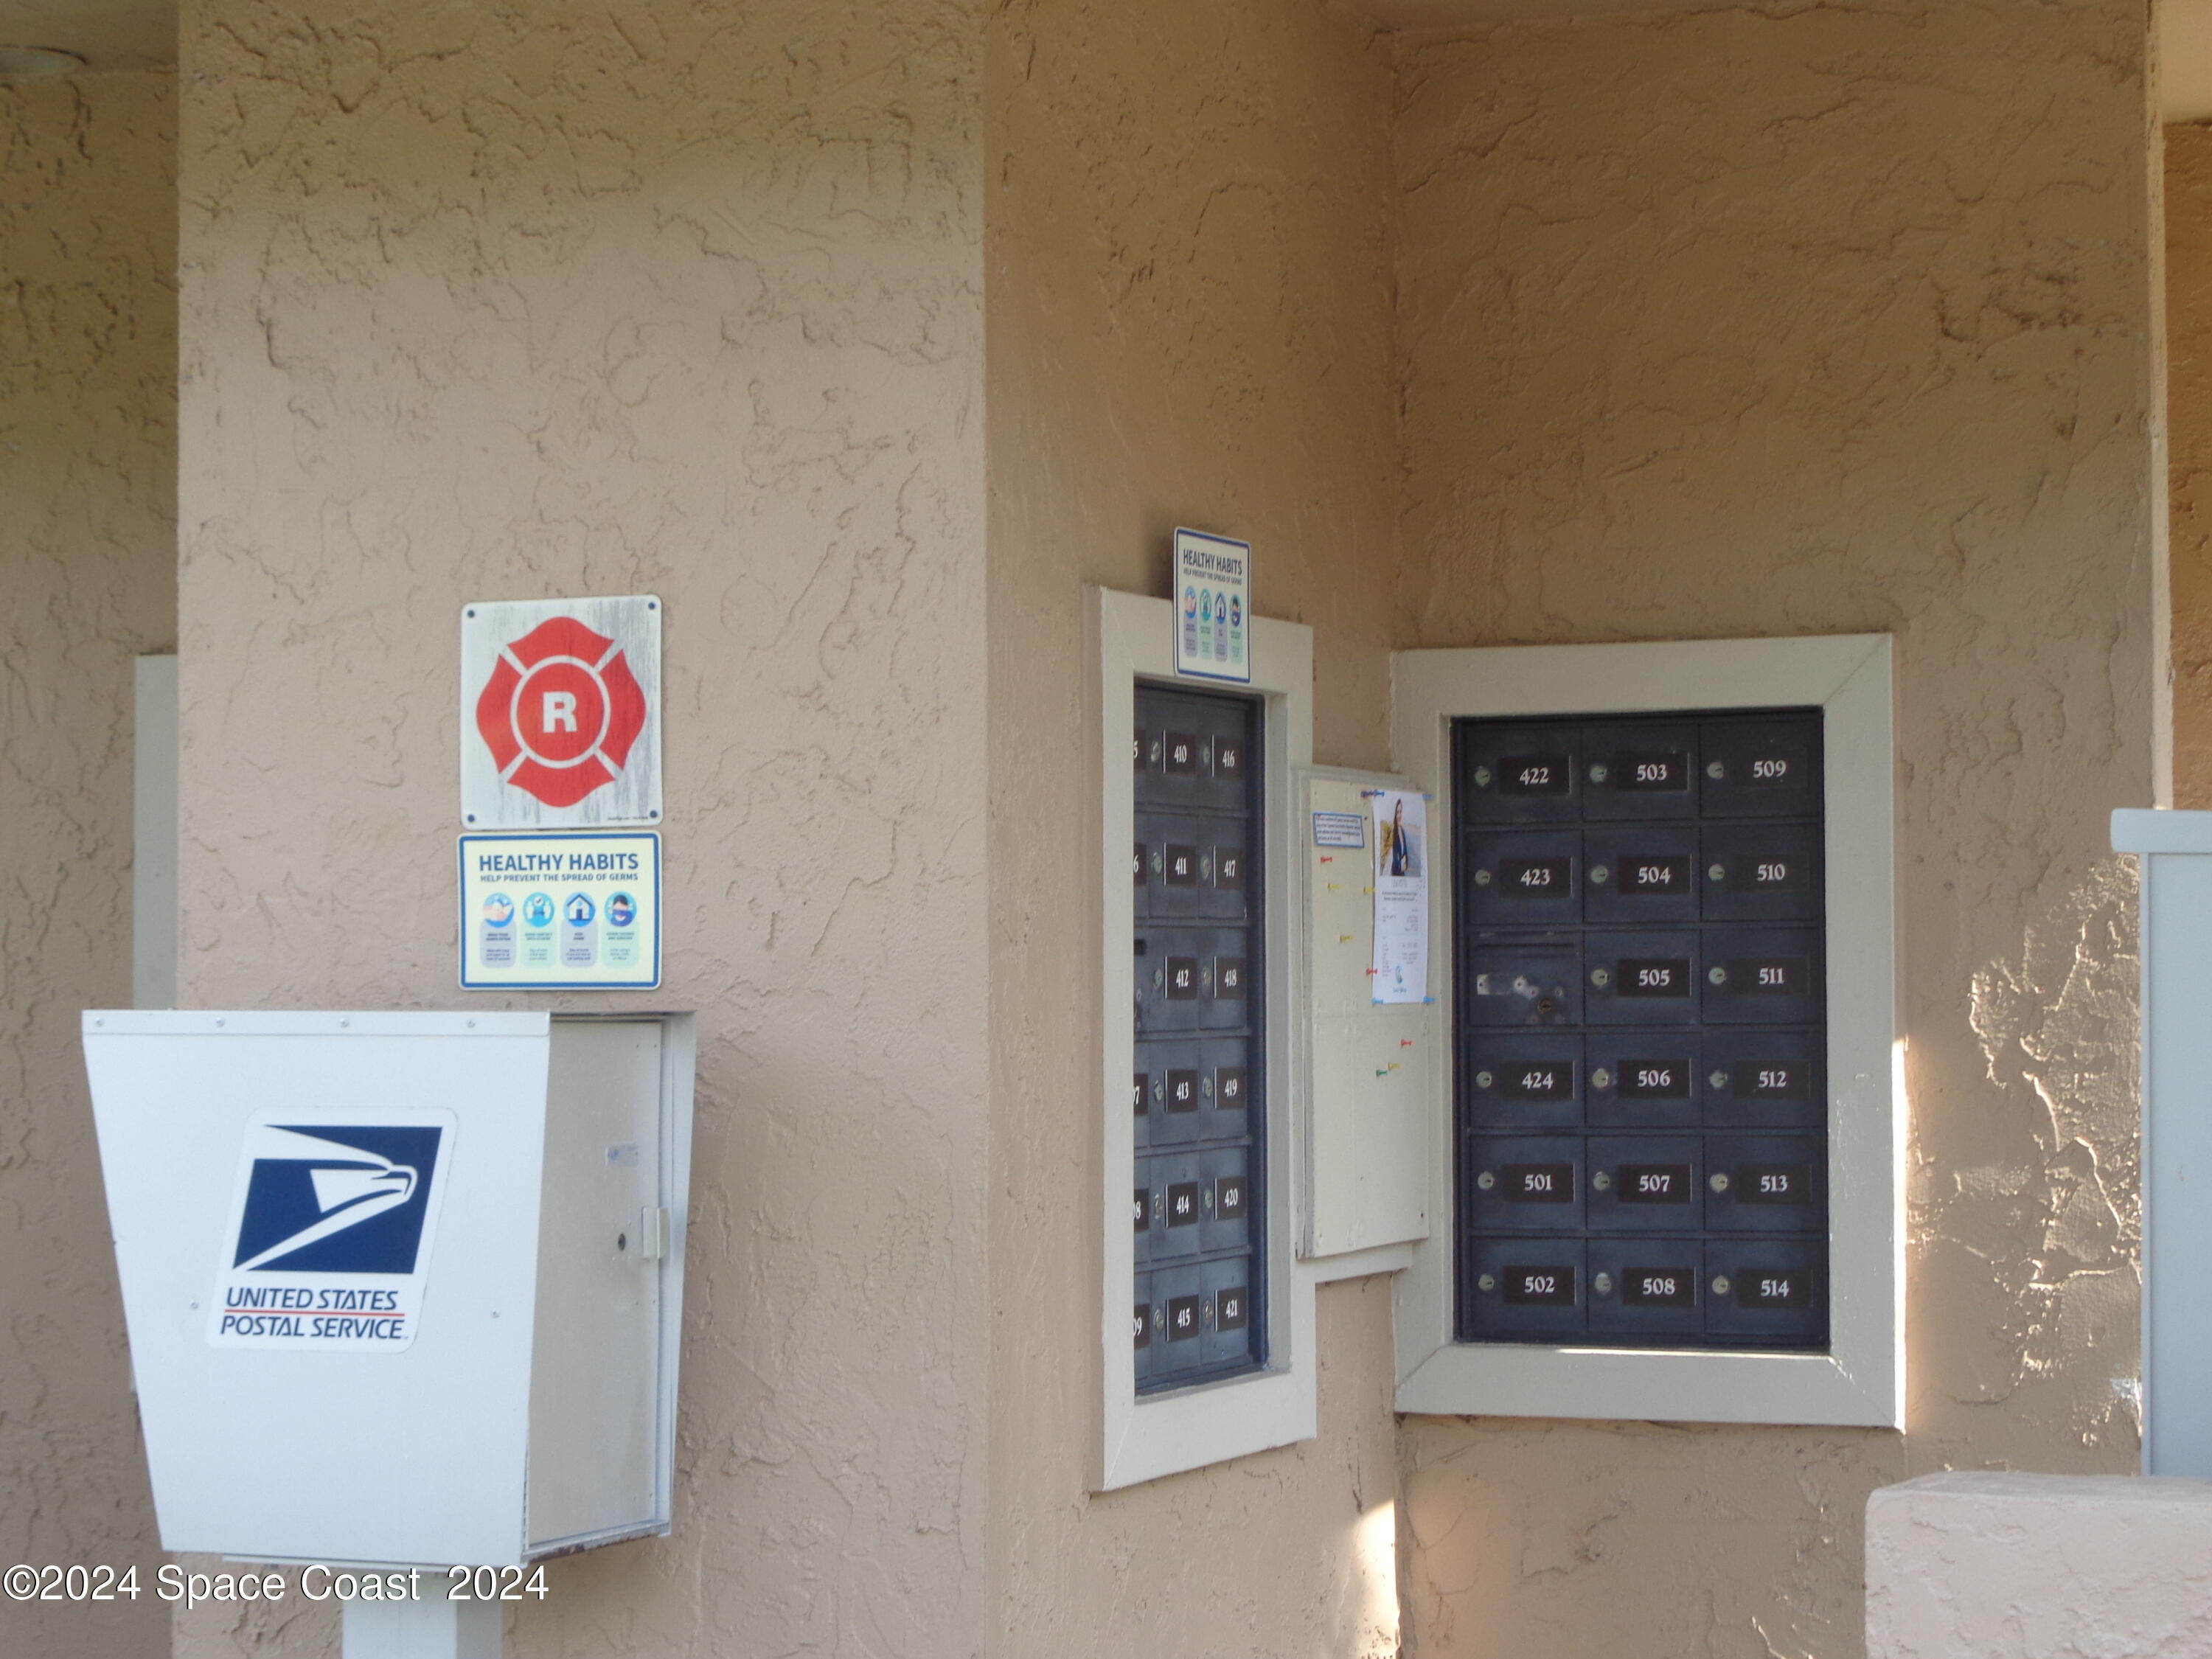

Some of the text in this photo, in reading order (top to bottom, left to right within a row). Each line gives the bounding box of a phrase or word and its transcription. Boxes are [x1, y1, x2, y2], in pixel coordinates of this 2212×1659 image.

[1183, 549, 1242, 575] HEALTHY HABITS
[543, 691, 577, 733] R
[1174, 744, 1187, 763] 410
[1222, 750, 1235, 768] 416
[1520, 768, 1548, 785] 422
[1637, 764, 1667, 781] 503
[1753, 760, 1787, 777] 509
[479, 853, 639, 872] HEALTHY HABITS
[1175, 857, 1187, 875] 411
[1224, 860, 1236, 877] 417
[1757, 863, 1785, 880] 510
[480, 873, 639, 883] HELP PREVENT THE SPREAD OF GERMS
[1521, 869, 1550, 886] 423
[1638, 866, 1670, 884] 504
[1176, 969, 1189, 988] 412
[1225, 969, 1237, 987] 418
[1638, 969, 1670, 987] 505
[1759, 967, 1784, 984] 511
[1522, 1071, 1554, 1090] 424
[1638, 1069, 1671, 1087] 506
[1759, 1071, 1787, 1088] 512
[1176, 1081, 1189, 1100] 413
[1224, 1078, 1238, 1097] 419
[1524, 1174, 1552, 1191] 501
[1639, 1174, 1670, 1192] 507
[1760, 1175, 1788, 1192] 513
[1176, 1195, 1190, 1215] 414
[1224, 1188, 1238, 1207] 420
[1524, 1276, 1555, 1293] 502
[1643, 1278, 1675, 1295] 508
[1761, 1279, 1790, 1297] 514
[226, 1287, 398, 1310] UNITED STATES
[1225, 1299, 1238, 1318] 421
[220, 1315, 405, 1339] POSTAL SERVICE
[1177, 1308, 1191, 1328] 415
